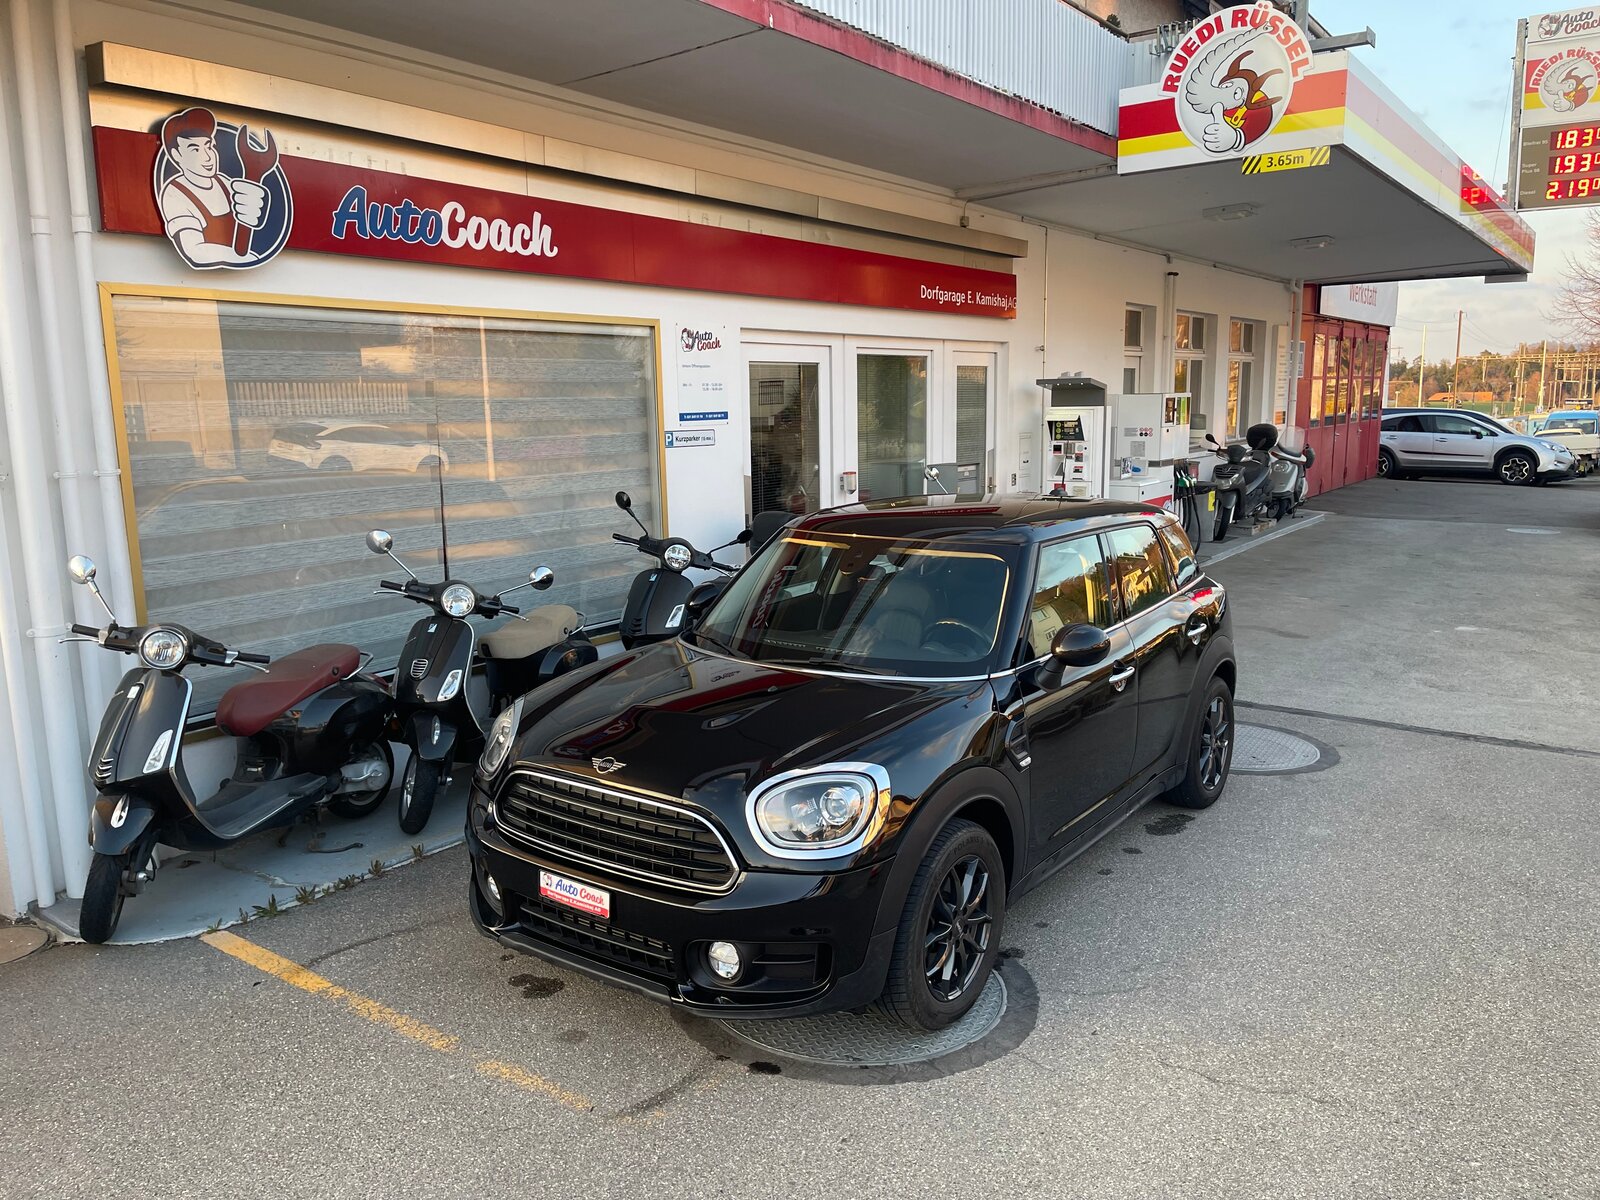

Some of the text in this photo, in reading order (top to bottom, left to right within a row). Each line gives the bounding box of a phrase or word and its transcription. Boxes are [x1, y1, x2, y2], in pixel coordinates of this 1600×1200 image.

[1561, 11, 1594, 24] Auto
[1565, 16, 1600, 35] Coac
[1162, 3, 1310, 93] RUEDI RÜSSEL
[1532, 52, 1564, 86] RUEDI
[1266, 153, 1304, 168] 3.65m
[920, 284, 966, 306] Dorfgarage
[967, 290, 975, 304] E.
[976, 291, 1008, 311] Kamishaj
[1349, 283, 1377, 307] Werkstatt
[694, 330, 713, 342] Auto
[697, 337, 722, 352] Coach
[675, 435, 701, 443] Kurzparker
[555, 878, 605, 906] Auto Coach
